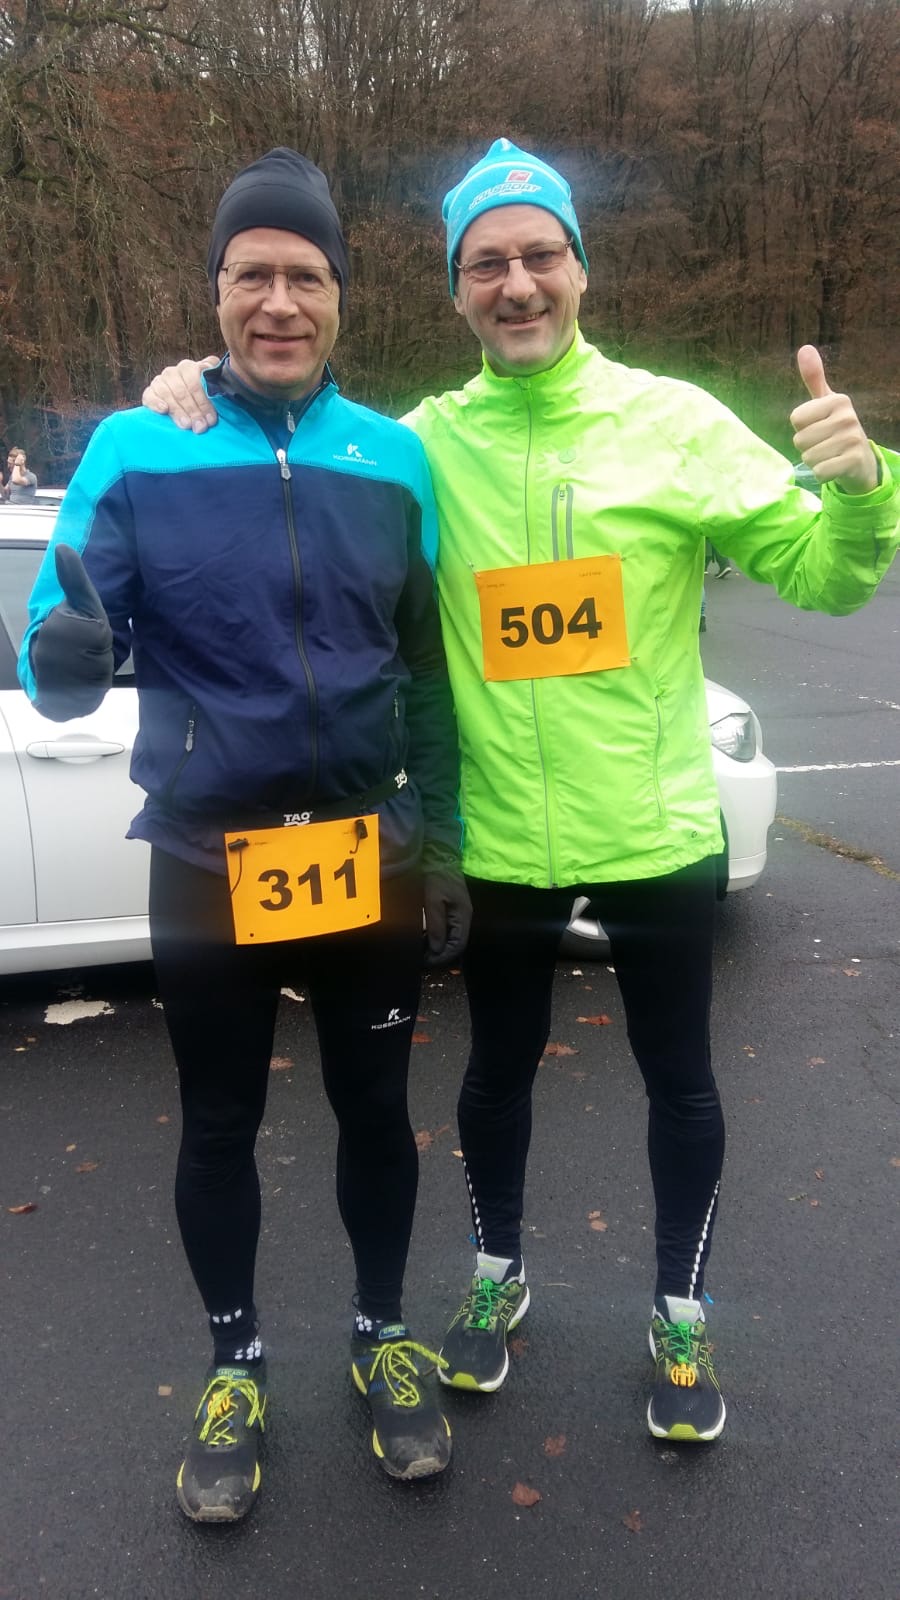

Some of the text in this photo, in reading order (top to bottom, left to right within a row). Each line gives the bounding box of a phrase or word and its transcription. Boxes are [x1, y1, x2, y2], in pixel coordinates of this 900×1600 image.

[500, 597, 603, 649] 504
[283, 811, 311, 822] TAO
[257, 857, 357, 912] 311
